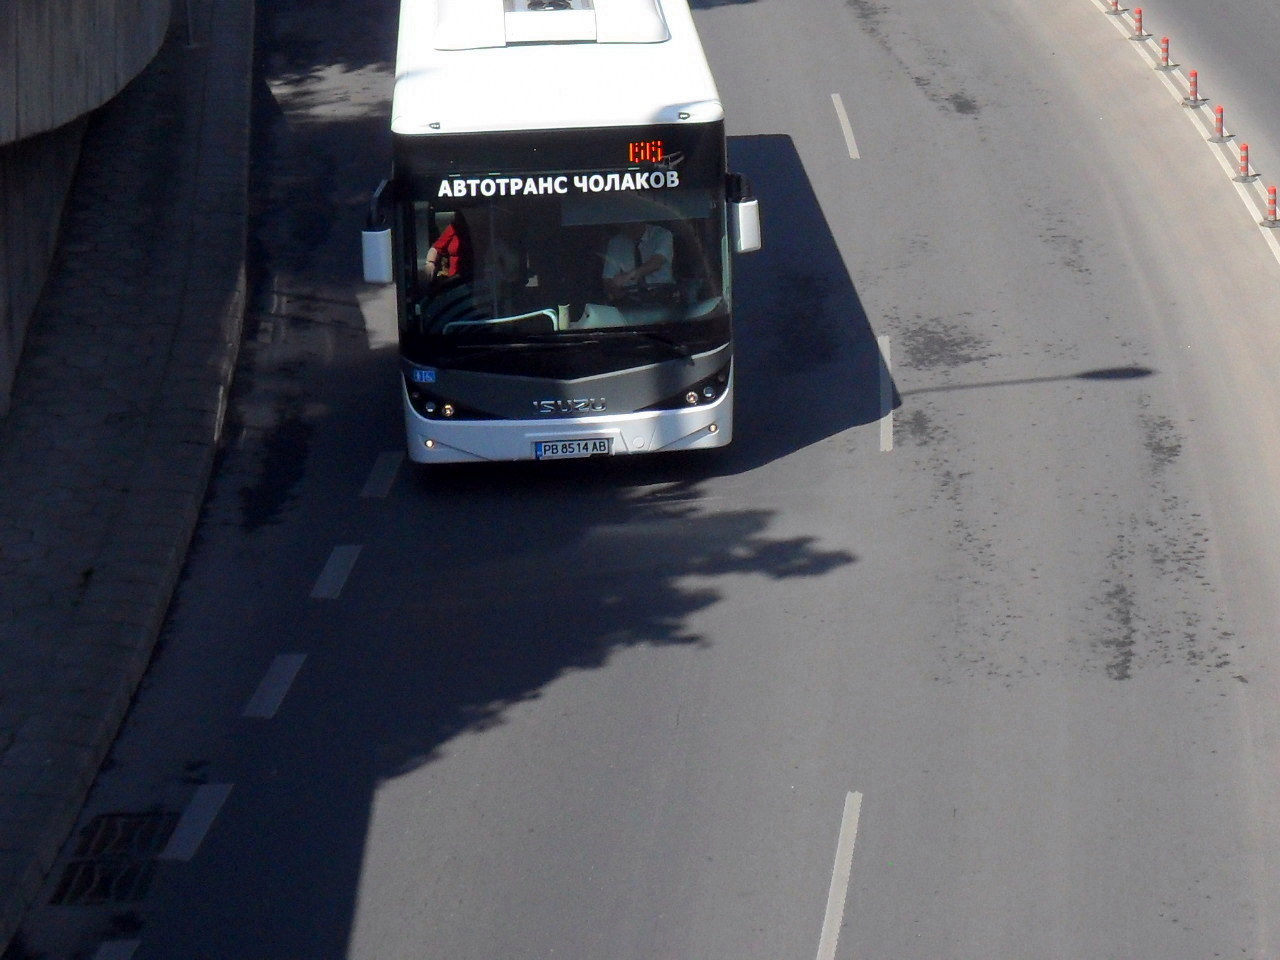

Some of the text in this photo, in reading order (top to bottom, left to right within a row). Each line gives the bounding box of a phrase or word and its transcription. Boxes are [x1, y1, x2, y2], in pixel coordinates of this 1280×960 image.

[438, 171, 680, 198] АВТОТРАНС ЧОЛАКОВ
[533, 397, 607, 414] ISUZU
